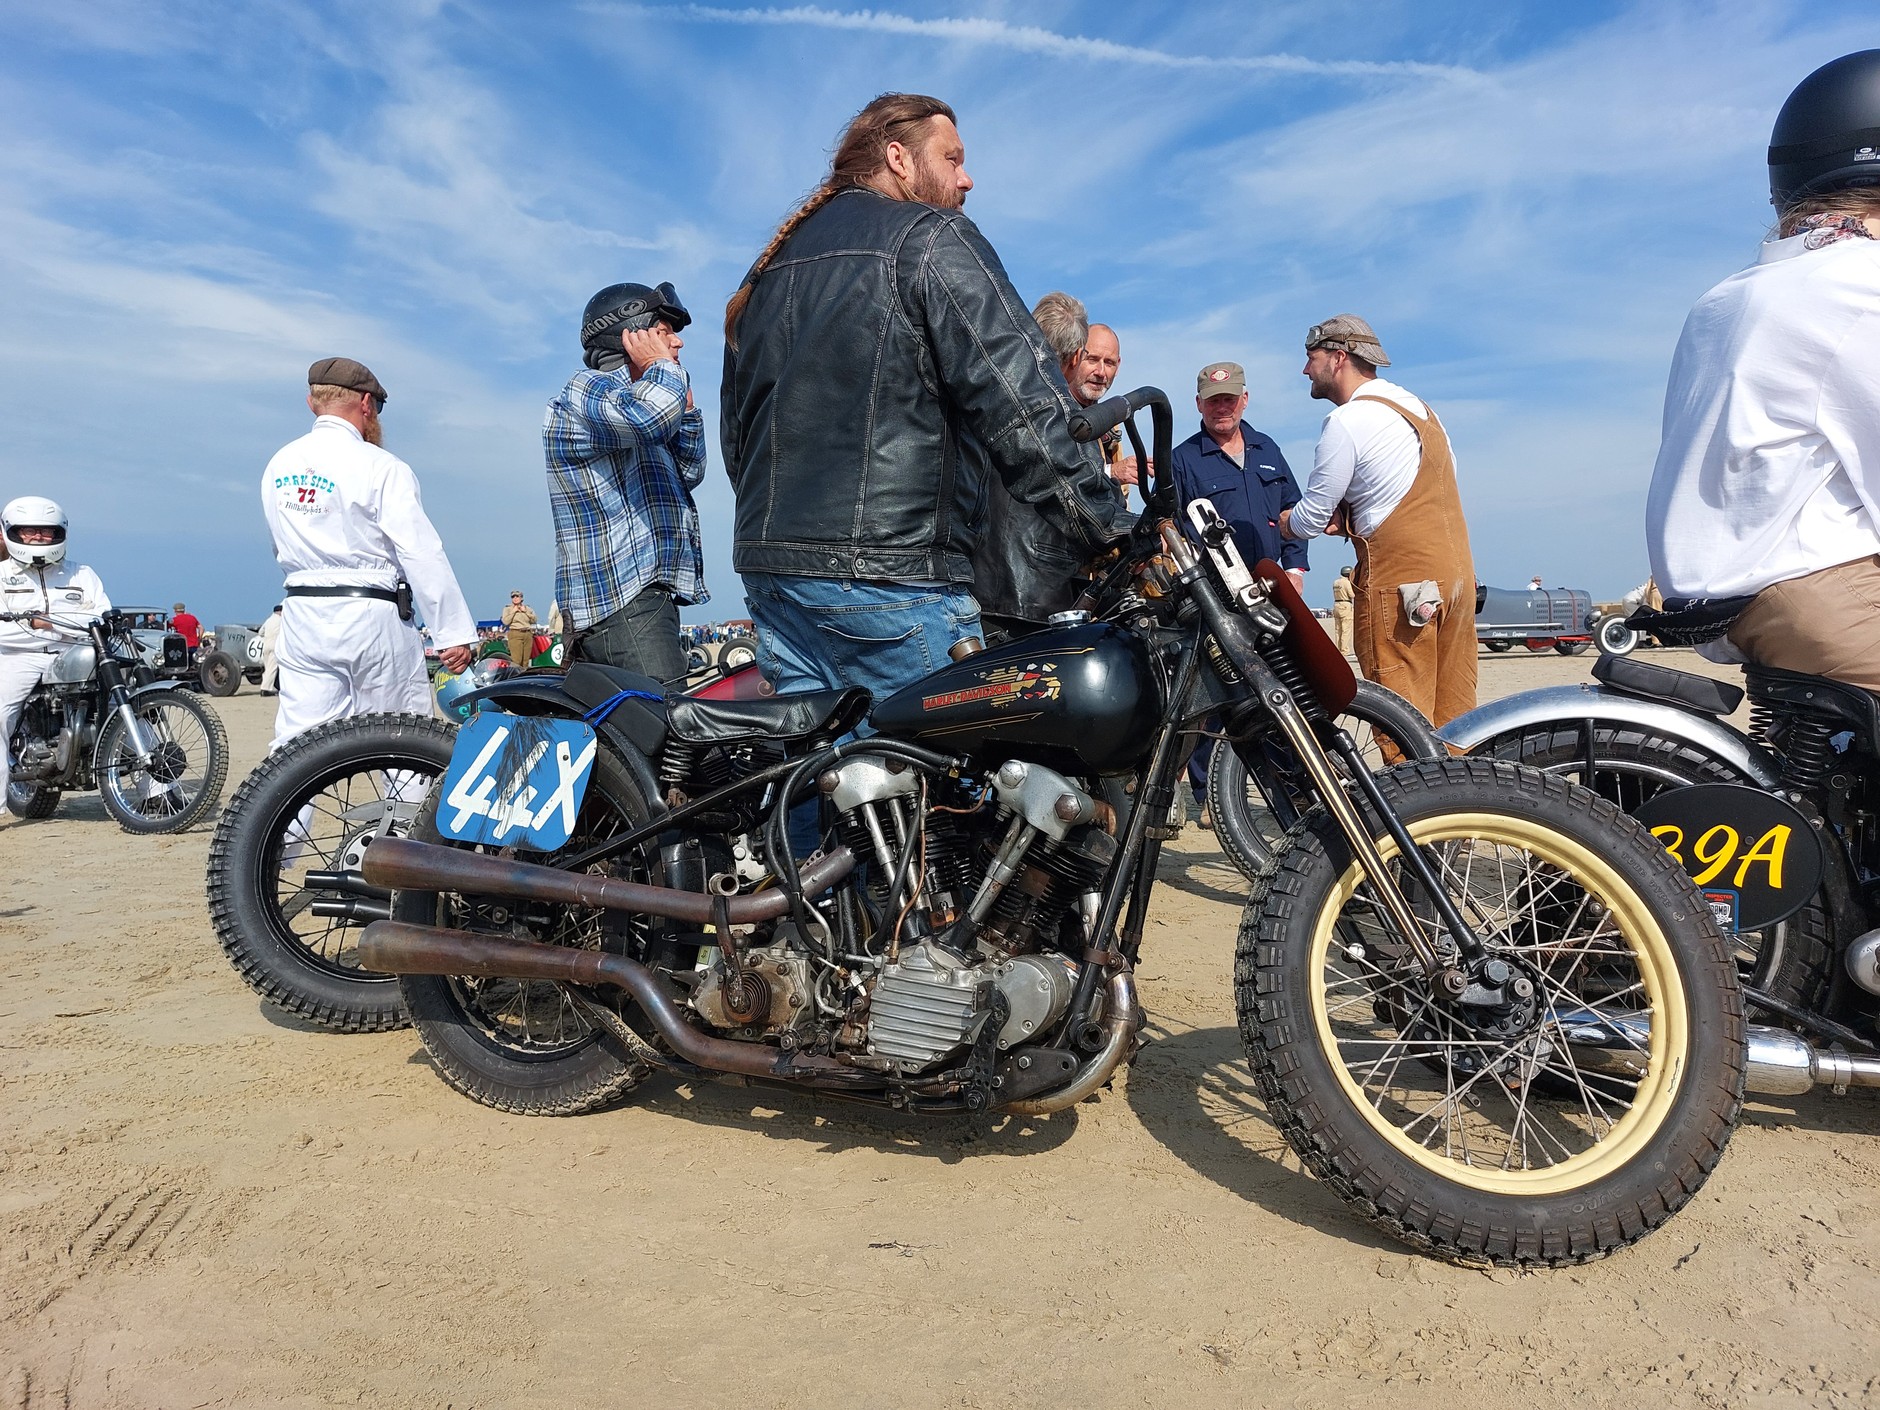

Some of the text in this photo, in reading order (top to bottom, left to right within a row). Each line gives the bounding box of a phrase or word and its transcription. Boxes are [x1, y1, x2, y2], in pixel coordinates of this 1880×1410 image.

[275, 475, 335, 493] DARK SIDE
[297, 487, 316, 503] 72
[248, 640, 264, 658] 64
[923, 683, 1012, 709] HARLEY-DAVIDSON
[447, 726, 598, 840] 44X
